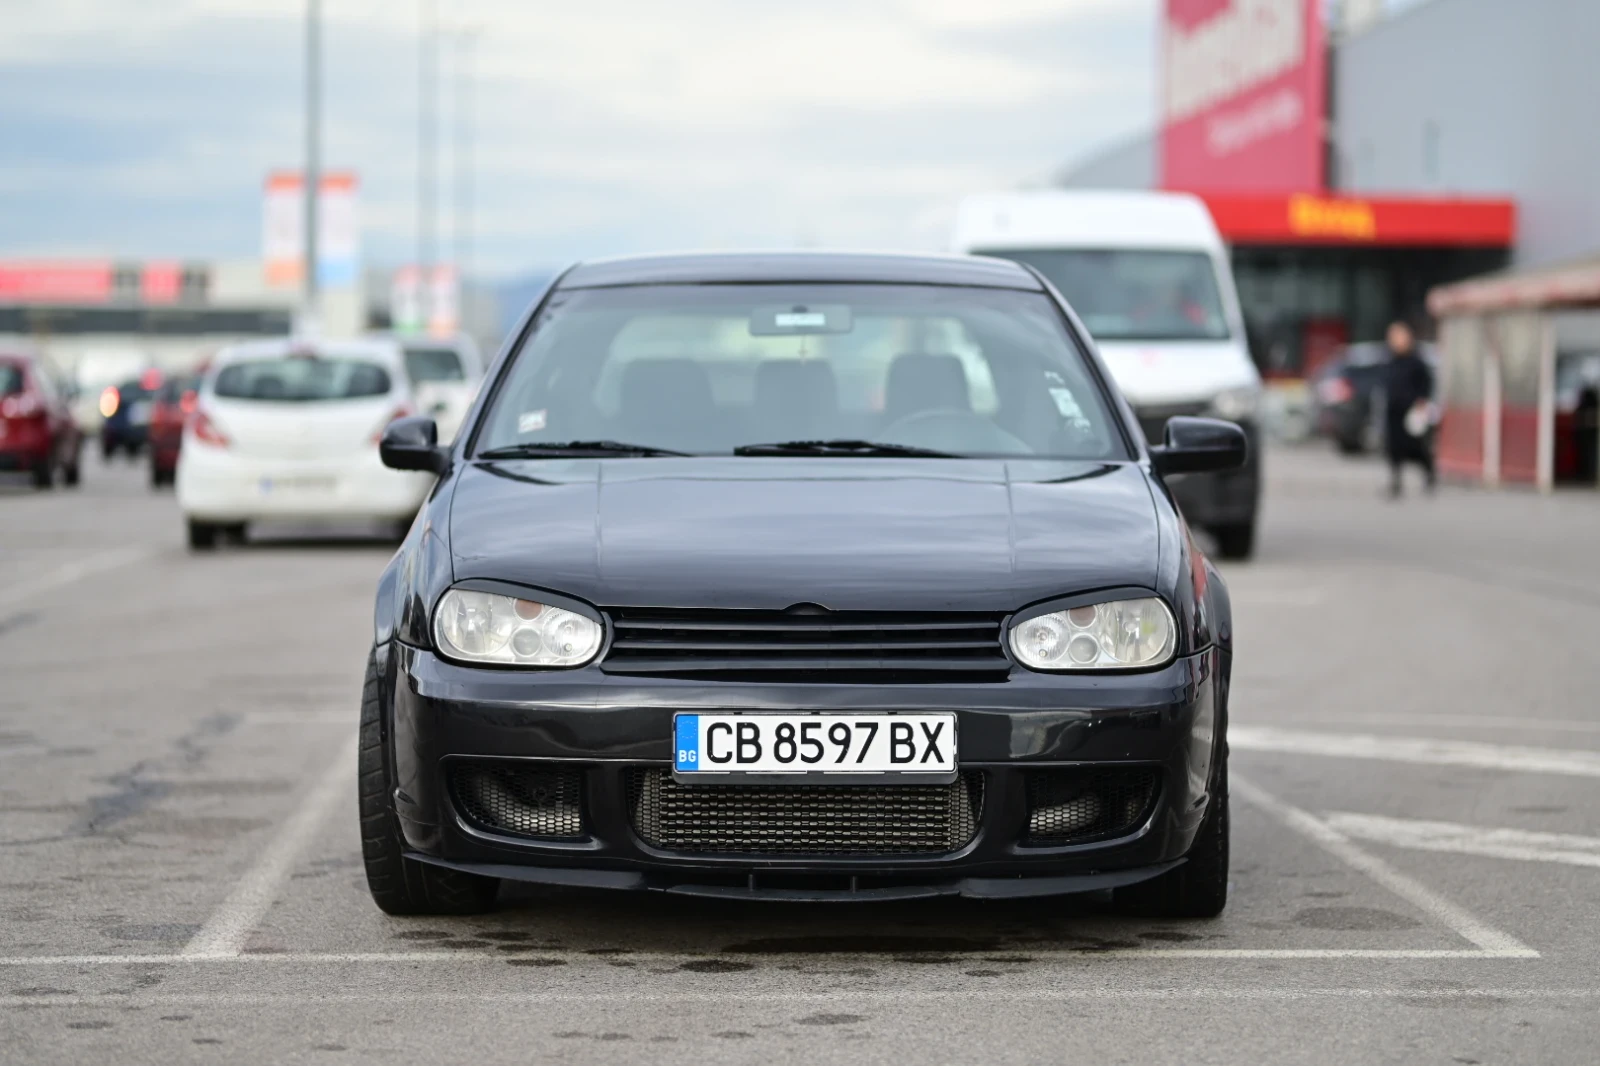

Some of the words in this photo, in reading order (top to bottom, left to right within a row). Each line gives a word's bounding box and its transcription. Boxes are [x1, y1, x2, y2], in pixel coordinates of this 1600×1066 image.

[678, 749, 698, 763] BG
[706, 722, 762, 764] CB
[773, 722, 879, 764] 8597
[890, 722, 945, 764] BX
